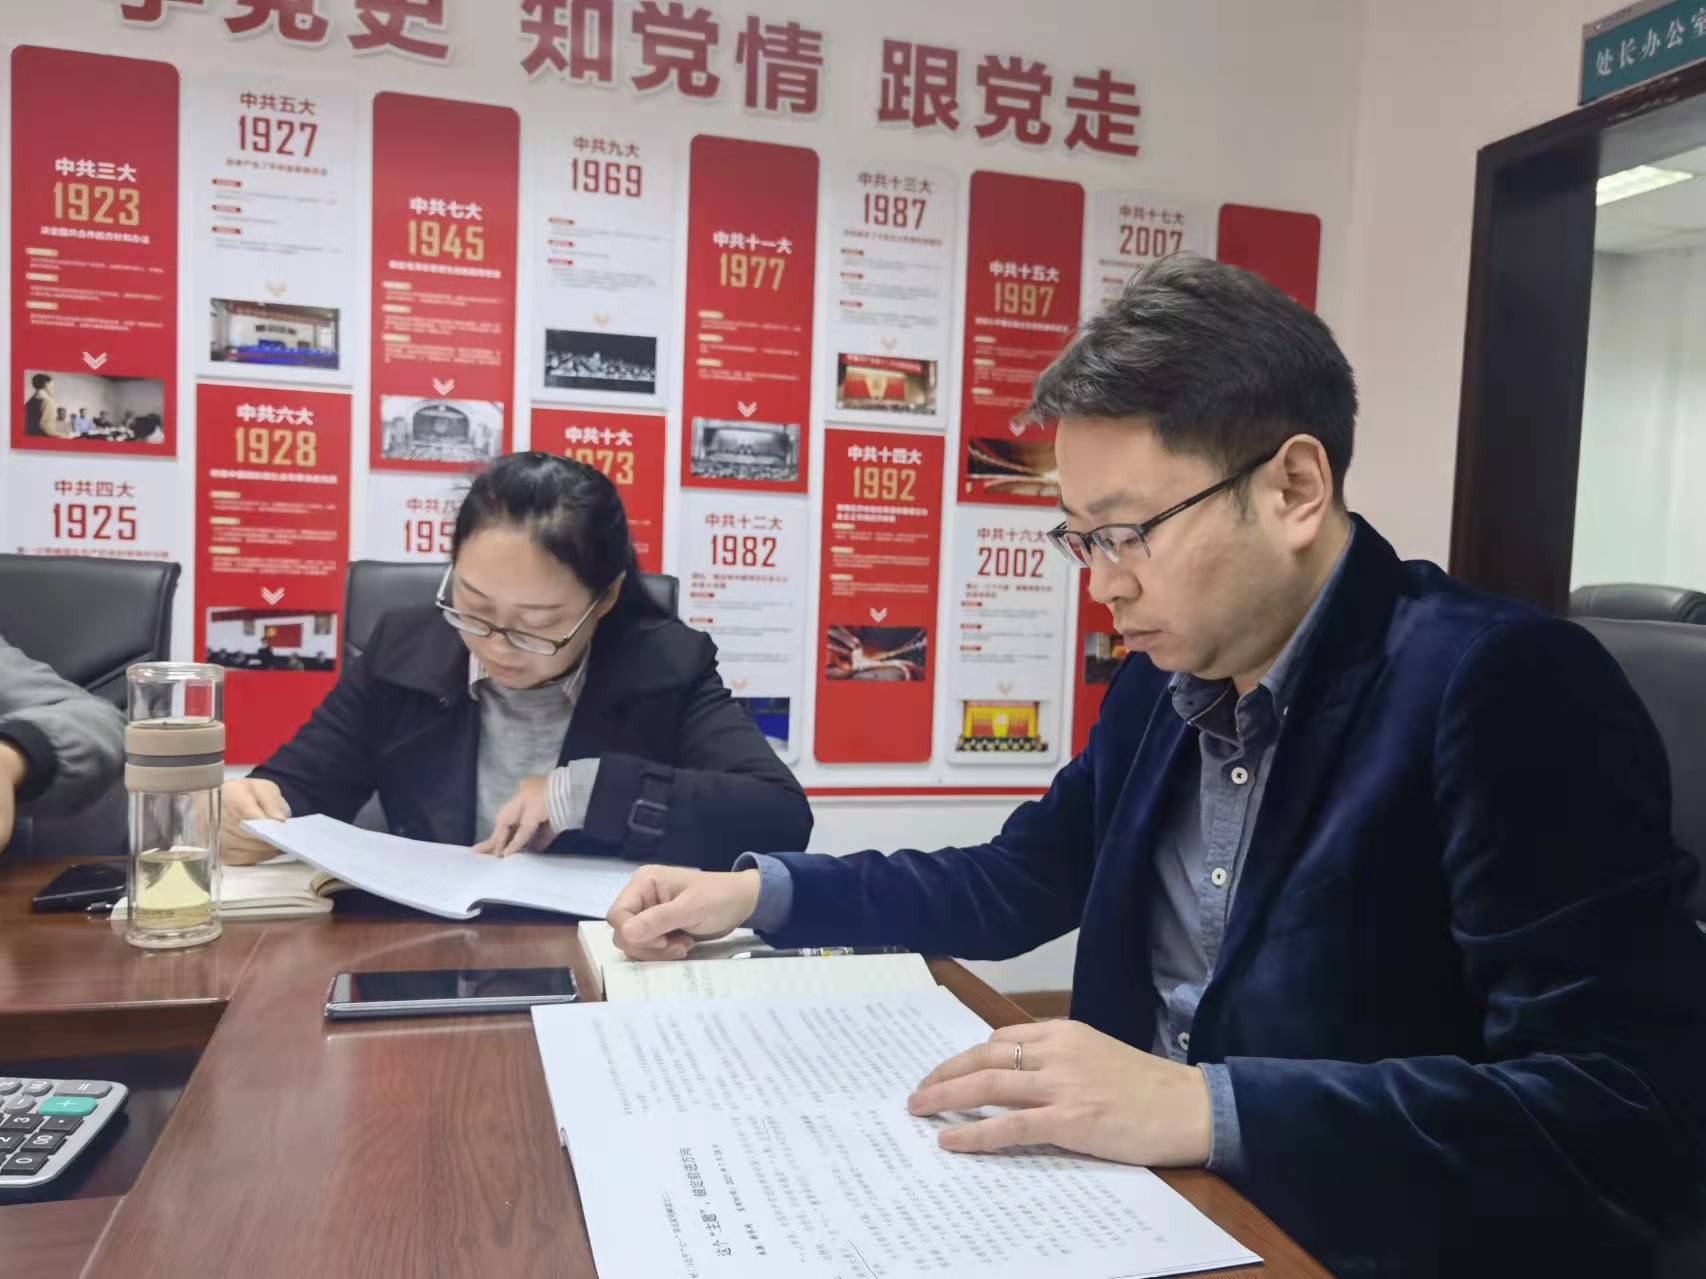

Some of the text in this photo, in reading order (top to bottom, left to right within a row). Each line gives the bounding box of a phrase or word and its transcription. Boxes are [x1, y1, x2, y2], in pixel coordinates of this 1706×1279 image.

[519, 0, 824, 114] 知党情
[877, 38, 1141, 157] 跟党走
[239, 92, 317, 116] 中共五大
[238, 115, 318, 158] 1927
[574, 136, 641, 159] 中共九大
[55, 157, 137, 183] 中共三大
[572, 158, 643, 198] 1969
[858, 172, 932, 195] 中共十三大
[53, 181, 140, 227] 1923
[409, 196, 483, 221] 中共七大
[863, 192, 927, 231] 1987
[407, 219, 485, 262] 1945
[713, 230, 793, 255] 中共十一大
[1119, 224, 1183, 257] 2007
[719, 252, 785, 292] 1977
[989, 259, 1061, 284] 中共十五大
[993, 281, 1055, 319] 1997
[236, 403, 315, 426] 中共六大
[235, 426, 317, 468] 1928
[564, 426, 634, 447] 中共十大
[847, 444, 923, 465] 中共十四大
[54, 480, 137, 499] 中共四大
[852, 466, 917, 501] 1992
[53, 503, 138, 541] 1925
[704, 513, 784, 531] 中共十二大
[977, 528, 1046, 544] 中共十六大
[711, 534, 777, 568] 1982
[977, 546, 1045, 578] 2002
